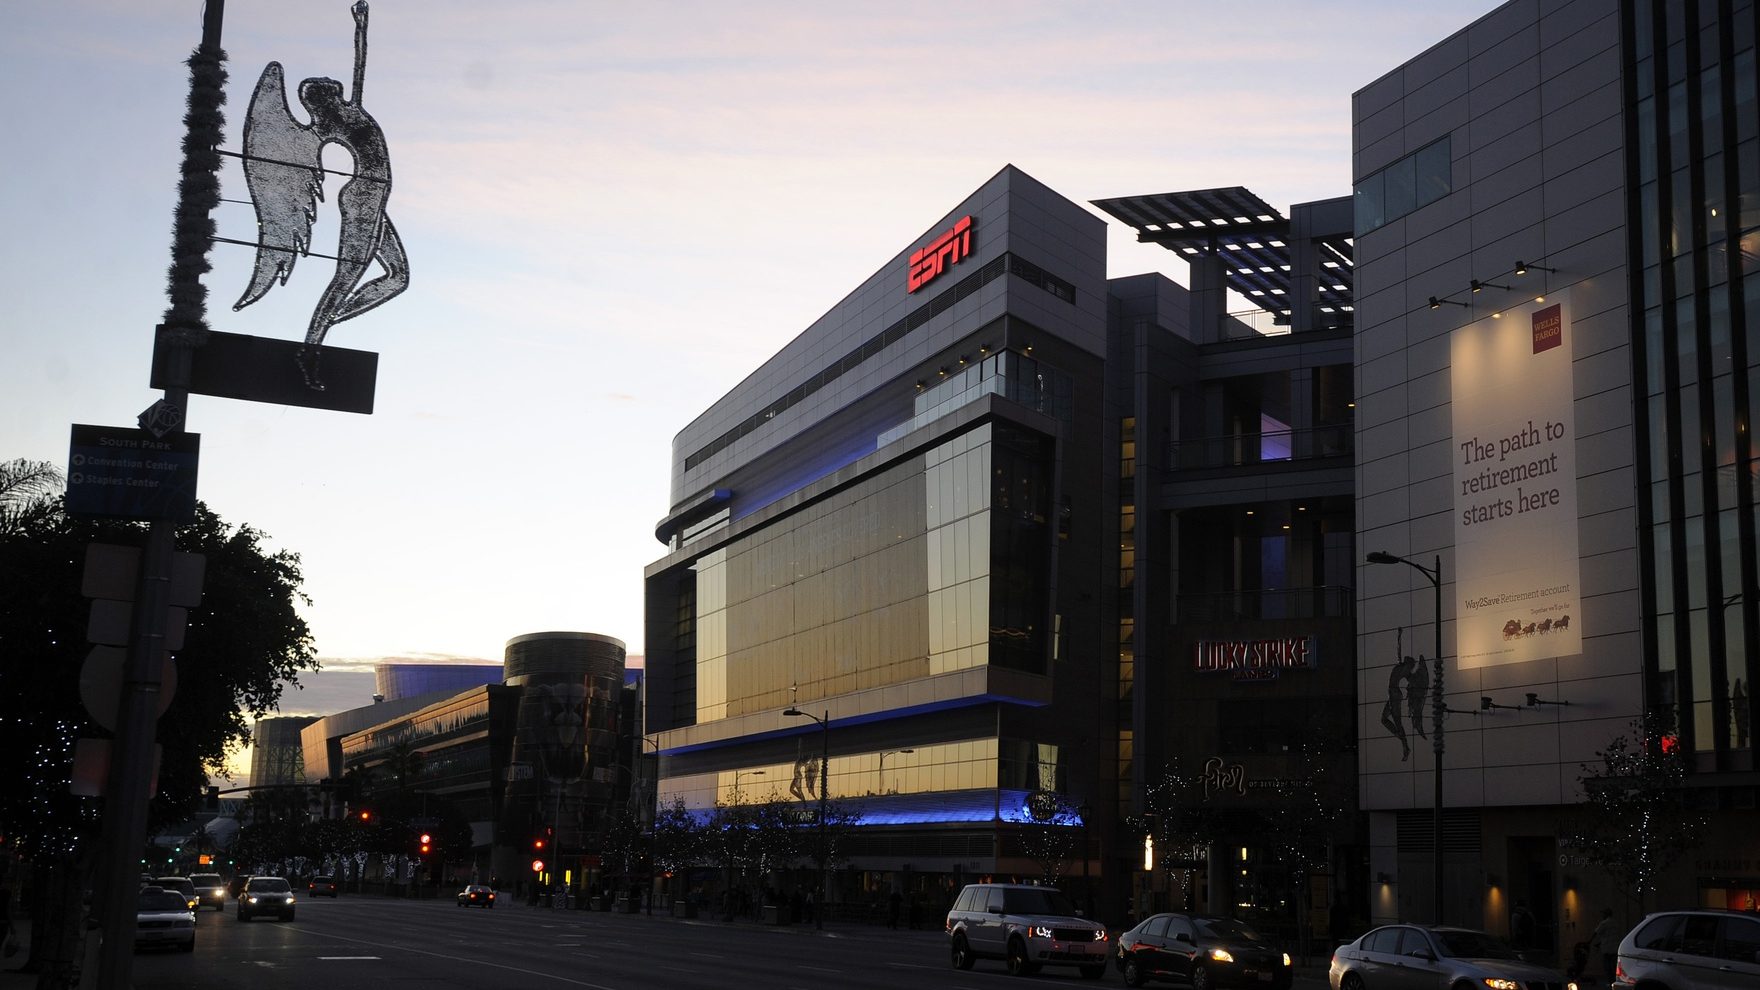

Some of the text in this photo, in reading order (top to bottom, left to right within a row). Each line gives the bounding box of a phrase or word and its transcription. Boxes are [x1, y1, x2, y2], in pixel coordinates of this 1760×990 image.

[908, 215, 973, 294] ESPN
[1534, 316, 1560, 332] WELLS
[1534, 326, 1560, 342] FARGO
[1461, 421, 1565, 465] The path to
[87, 456, 179, 471] Convention Center
[1462, 452, 1558, 496] retirement
[86, 474, 160, 488] Staples Center
[1463, 487, 1560, 526] starts here
[1500, 589, 1539, 604] Retirement
[1540, 583, 1570, 597] account
[1194, 636, 1311, 671] LUCKY STRIKE
